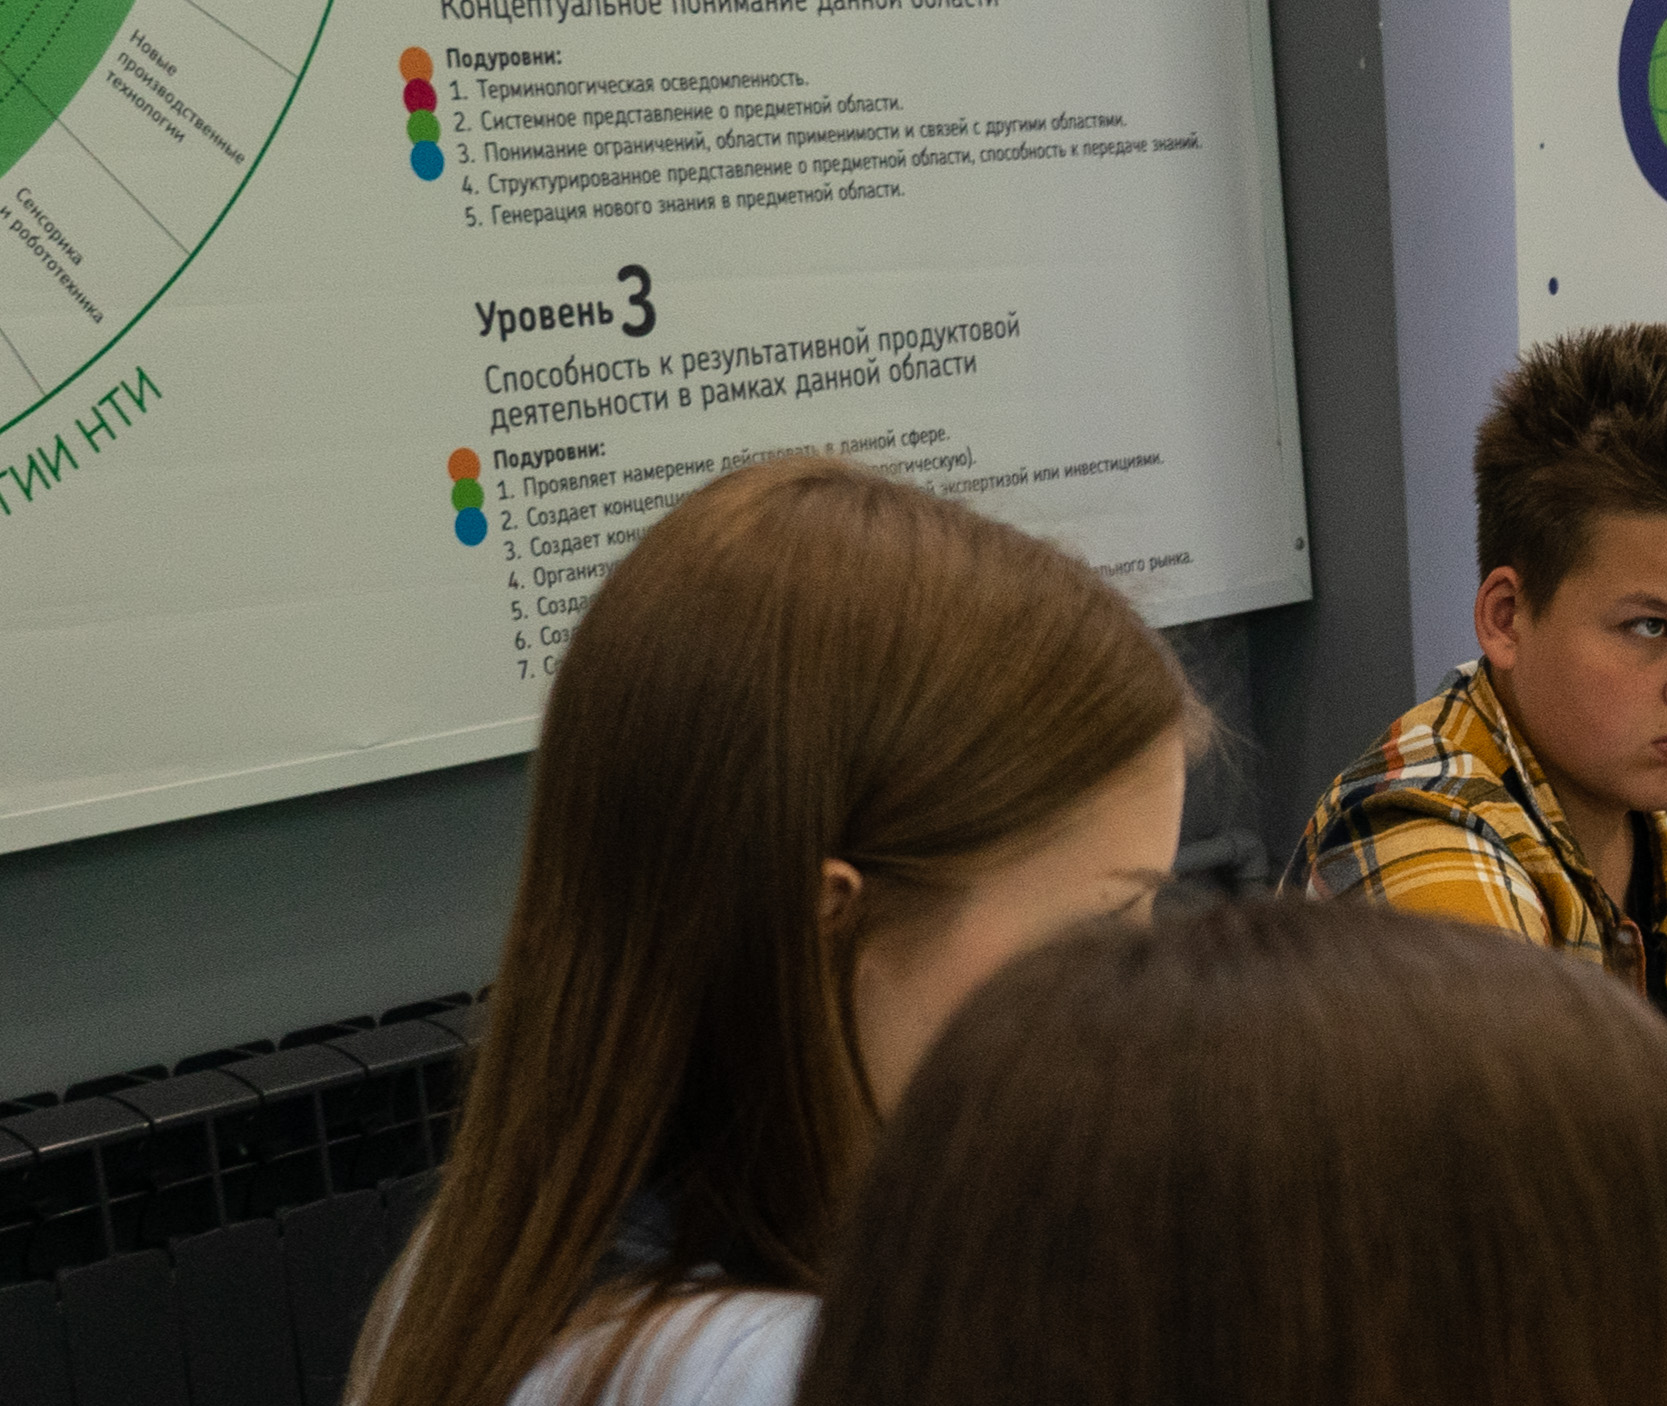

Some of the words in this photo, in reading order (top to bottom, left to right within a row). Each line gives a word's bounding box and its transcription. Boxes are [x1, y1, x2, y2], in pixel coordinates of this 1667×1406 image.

[129, 29, 178, 77] Новые
[446, 48, 562, 71] Подуровни:
[106, 69, 186, 143] технологии
[117, 52, 245, 165] производственные
[450, 80, 468, 101] 1.
[477, 76, 654, 103] Терминологическая
[661, 71, 809, 93] осведомленность.
[454, 111, 472, 132] 2.
[481, 110, 576, 131] Системное
[583, 104, 713, 127] представление
[720, 104, 728, 119] о
[734, 95, 832, 121] предметной
[838, 94, 904, 113] области.
[458, 144, 475, 164] 3.
[485, 142, 587, 163] Понимание
[594, 131, 711, 158] ограничений,
[717, 129, 781, 150] области
[787, 124, 900, 148] применимости
[920, 117, 969, 138] связей
[986, 116, 1046, 138] другими
[462, 176, 479, 195] 4.
[489, 167, 661, 197] Структурированное
[668, 159, 792, 185] представление
[799, 160, 807, 174] о
[813, 149, 906, 174] предметной
[980, 141, 1066, 163] способность
[1084, 137, 1147, 158] передаче
[16, 187, 83, 265] Сенсорика
[465, 207, 482, 227] 5.
[492, 203, 586, 226] Генерация
[593, 201, 652, 217] нового
[659, 195, 716, 214] знания
[722, 194, 730, 208] в
[737, 183, 833, 210] предметной
[839, 181, 905, 200] области.
[9, 219, 103, 324] робототехника
[475, 301, 613, 342] Уровень
[617, 264, 656, 337] 3
[486, 355, 651, 394] Способность
[661, 356, 673, 375] к
[682, 326, 870, 378] результативной
[879, 311, 1020, 355] продуктовой
[75, 366, 163, 453] НТИ
[490, 389, 668, 435] деятельности
[679, 387, 691, 406] в
[702, 377, 787, 410] рамках
[795, 358, 880, 398] данной
[889, 354, 977, 382] области
[494, 442, 606, 470] Подуровни:
[498, 481, 515, 500] 1.
[523, 470, 616, 499] Проявляет
[623, 457, 714, 483] намерение
[901, 428, 950, 447] сфере.
[501, 511, 518, 531] 2.
[527, 503, 597, 527] Создает
[504, 541, 521, 560] 3.
[531, 533, 600, 557] Создает
[941, 467, 1029, 494] экспертизой
[1034, 468, 1059, 483] или
[1064, 453, 1164, 477] инвестициями.
[508, 571, 525, 590] 4.
[512, 600, 528, 620] 5.
[537, 594, 592, 616] Созда
[515, 631, 532, 650] 6.
[517, 660, 535, 680] 7.
